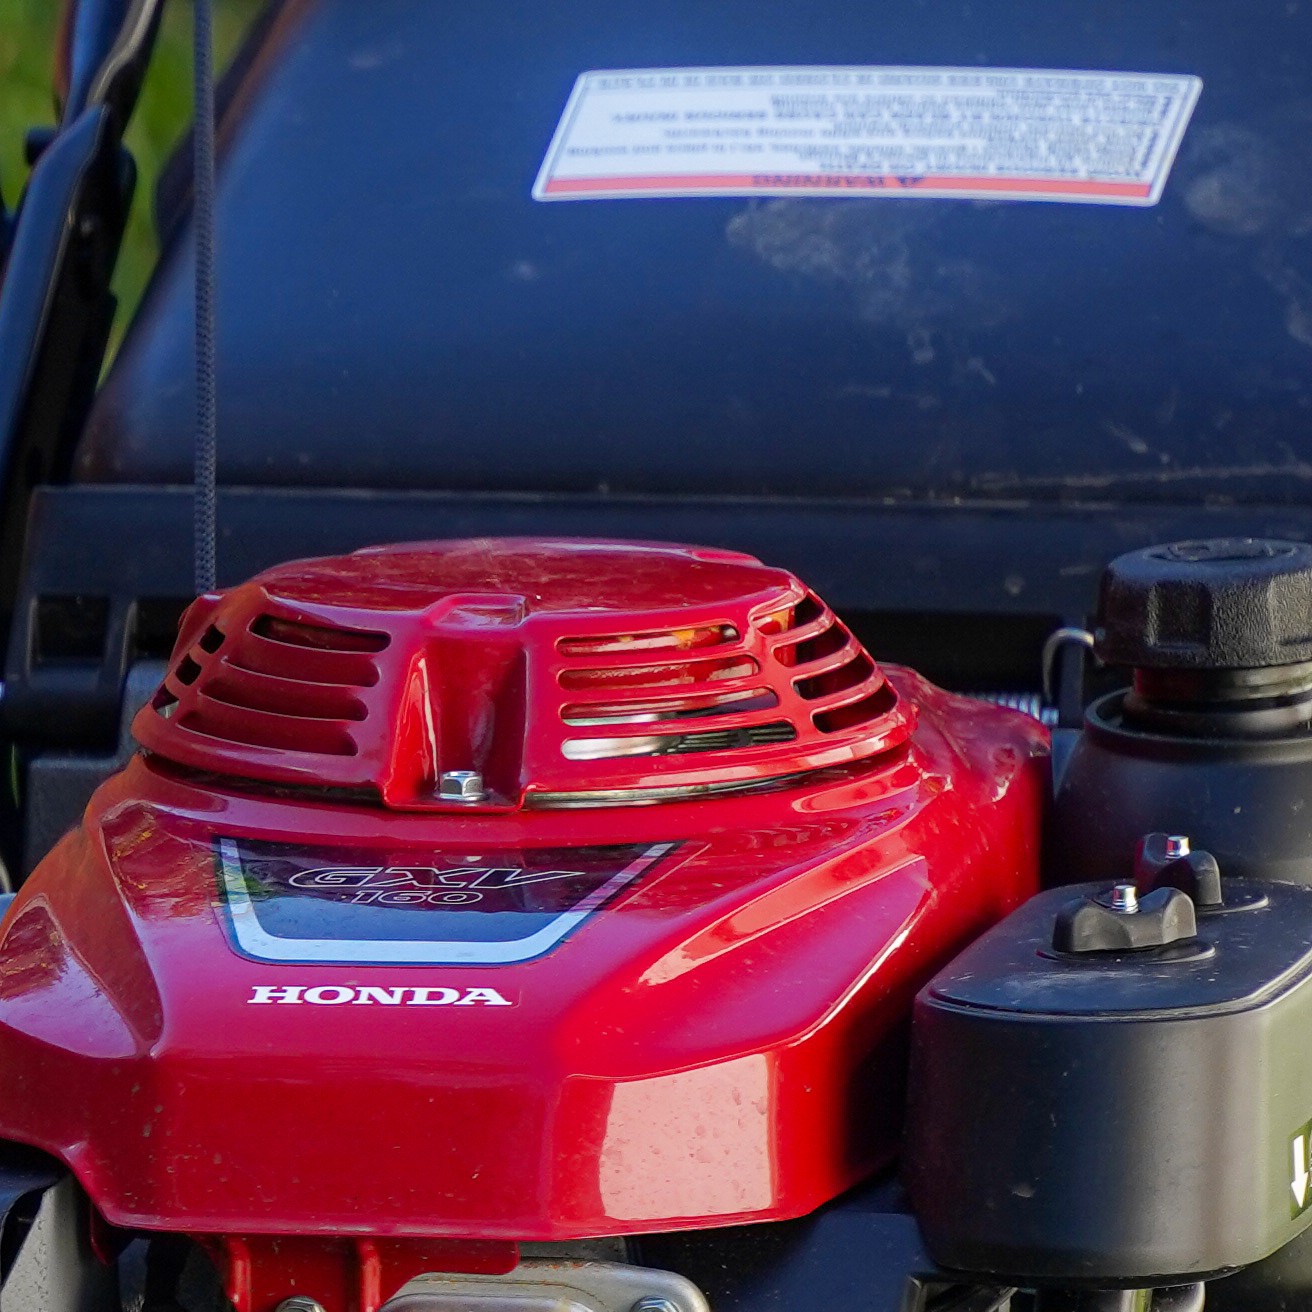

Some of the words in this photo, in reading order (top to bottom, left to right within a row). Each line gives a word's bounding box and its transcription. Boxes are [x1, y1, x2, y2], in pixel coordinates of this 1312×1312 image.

[288, 867, 586, 889] GXV
[350, 890, 484, 905] 160
[247, 985, 513, 1007] HONDA
